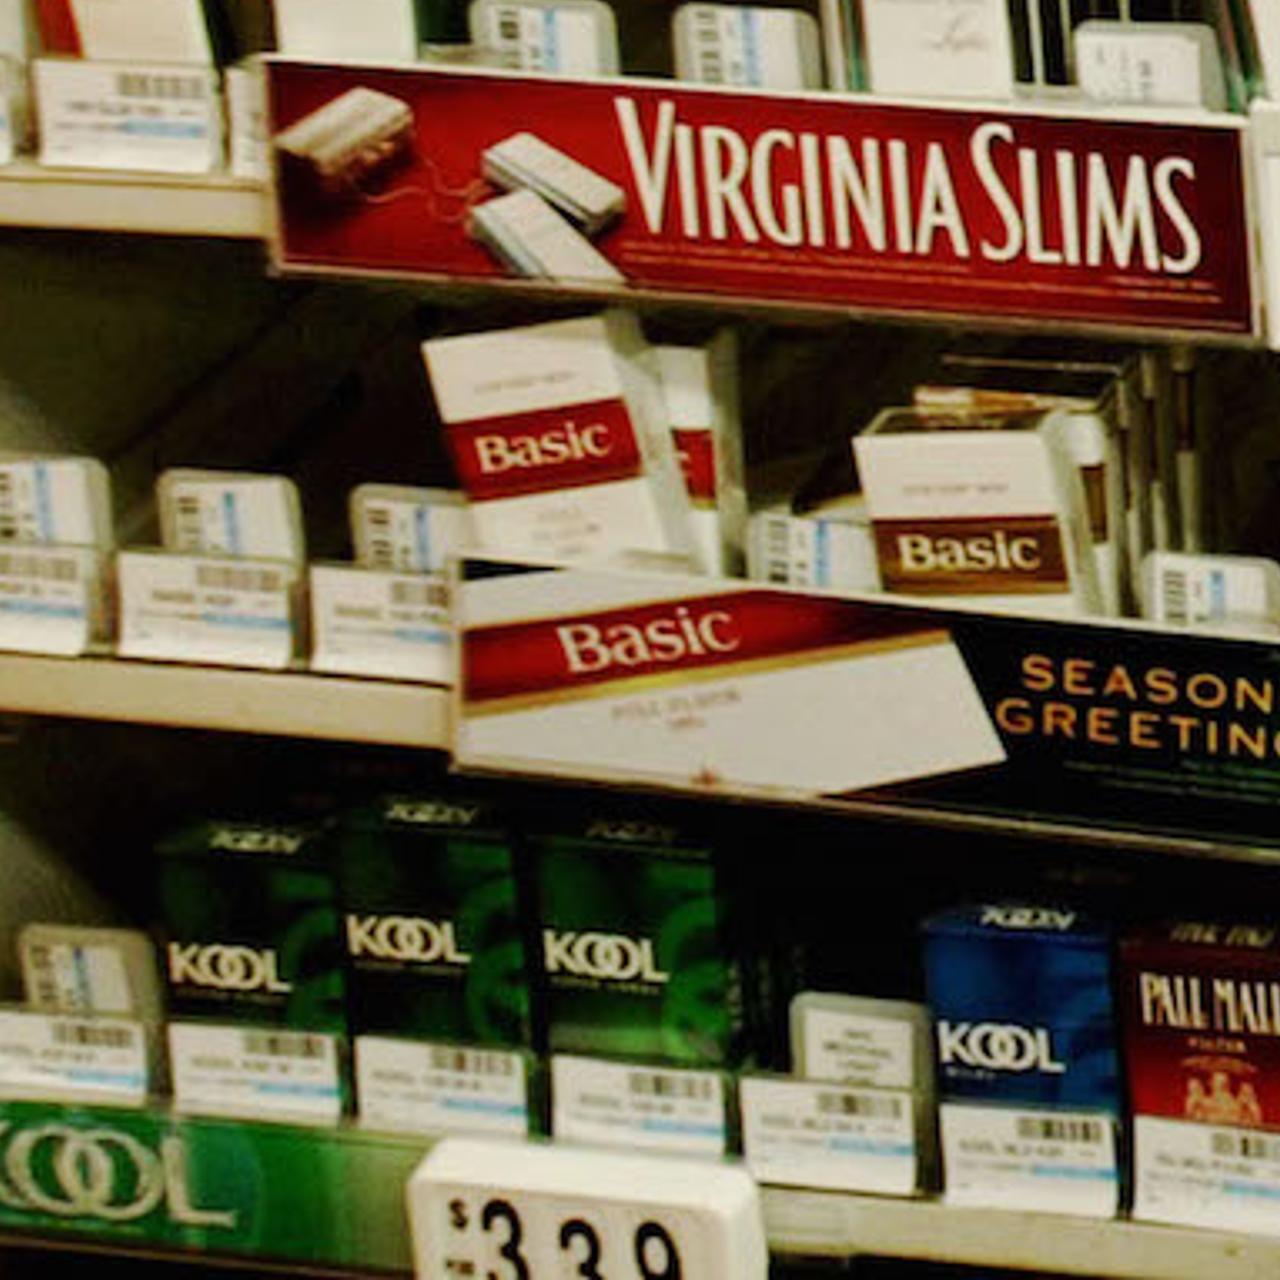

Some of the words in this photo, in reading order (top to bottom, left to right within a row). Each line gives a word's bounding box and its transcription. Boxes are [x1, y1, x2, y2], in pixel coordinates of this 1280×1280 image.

[614, 97, 971, 258] VIRGINIA
[972, 122, 1202, 276] SLIMS
[476, 419, 611, 475] Basic
[899, 529, 1042, 572] Basic
[556, 609, 742, 675] Basic
[169, 940, 292, 994] KOOL
[346, 915, 472, 964] KOOL
[543, 928, 670, 983] KOOL
[1140, 972, 1206, 1031] PALL
[938, 1021, 1066, 1074] KOOL
